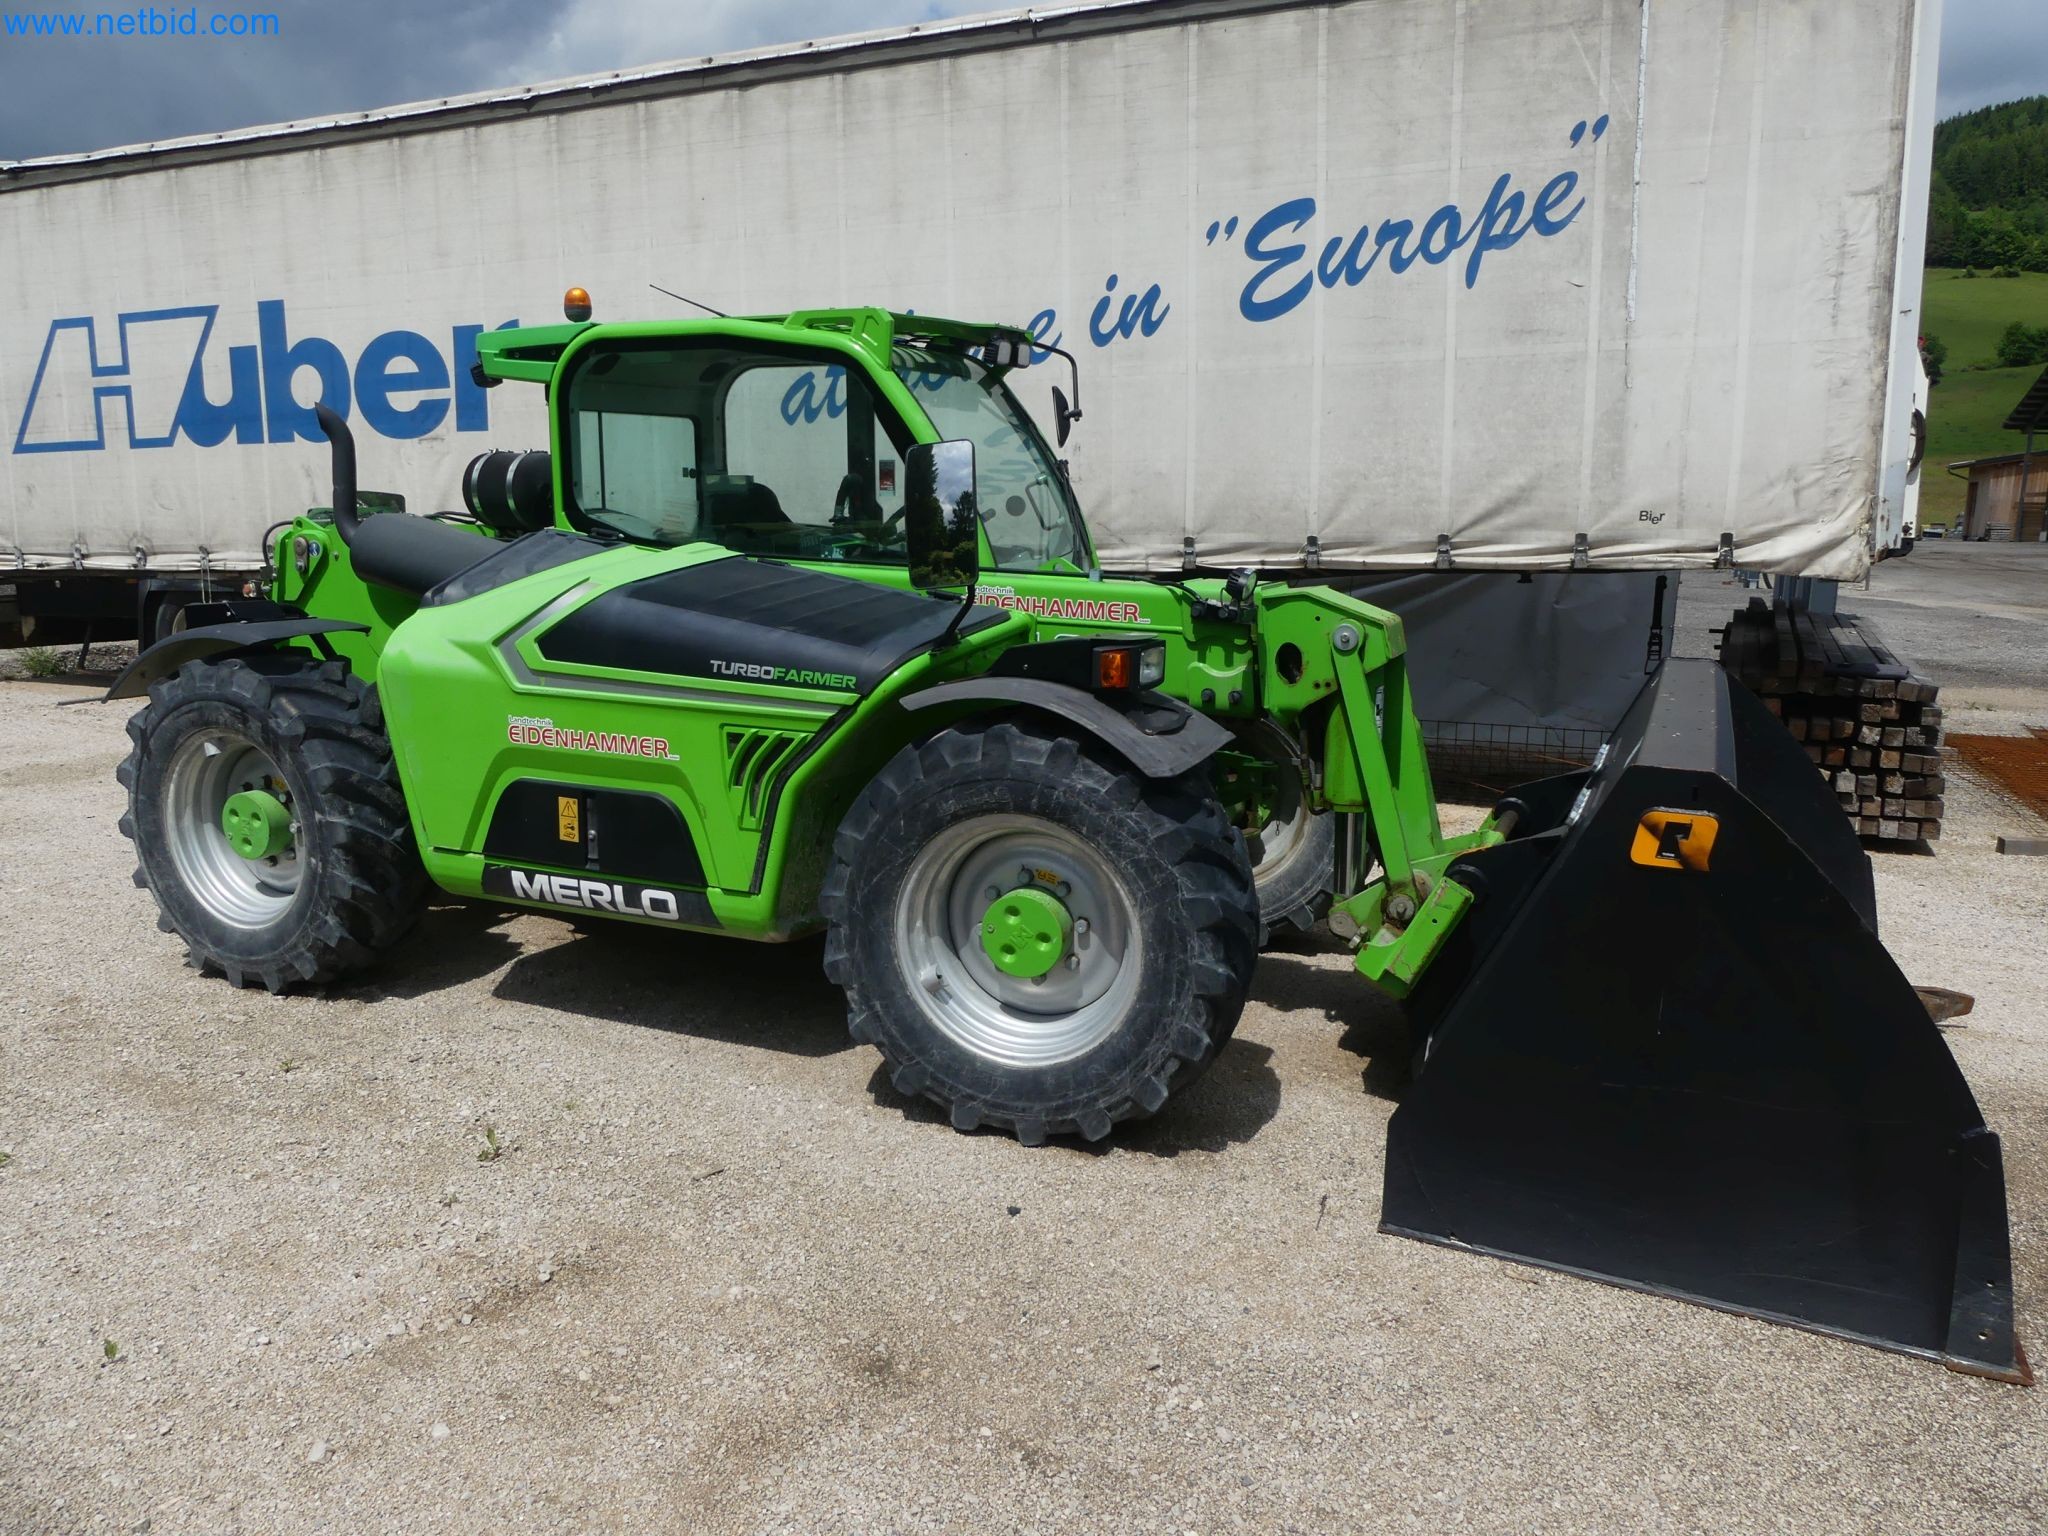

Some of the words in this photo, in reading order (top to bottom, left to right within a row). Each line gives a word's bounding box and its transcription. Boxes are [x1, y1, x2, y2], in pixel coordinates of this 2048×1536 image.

[1089, 273, 1170, 348] in
[13, 299, 520, 455] Huber
[1638, 510, 1666, 525] Bier
[710, 659, 857, 689] TURBOFARMER
[508, 714, 553, 727] Landtechnik
[508, 725, 670, 759] EIDENHAMMER
[511, 870, 680, 921] MERLO
